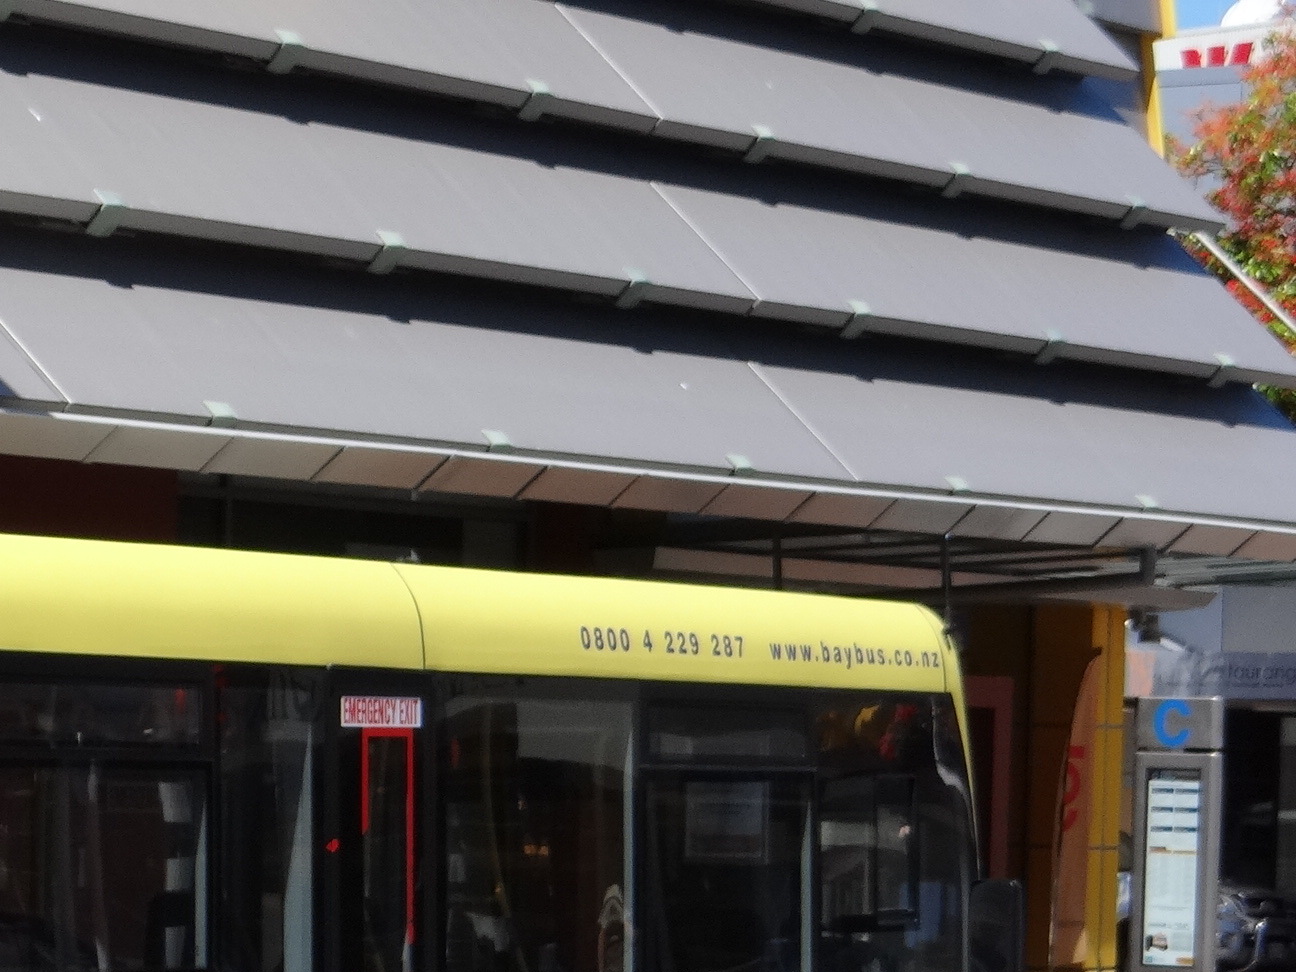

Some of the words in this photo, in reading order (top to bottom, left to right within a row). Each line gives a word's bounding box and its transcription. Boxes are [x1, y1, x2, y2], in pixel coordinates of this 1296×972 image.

[580, 626, 630, 652] 0800
[642, 629, 653, 653] 4
[663, 631, 700, 655] 229
[710, 633, 745, 658] 287
[768, 641, 940, 669] www.baybus.co.nz
[344, 698, 396, 724] EMERGENCY
[399, 699, 419, 725] EXIT
[1153, 698, 1192, 748] C
